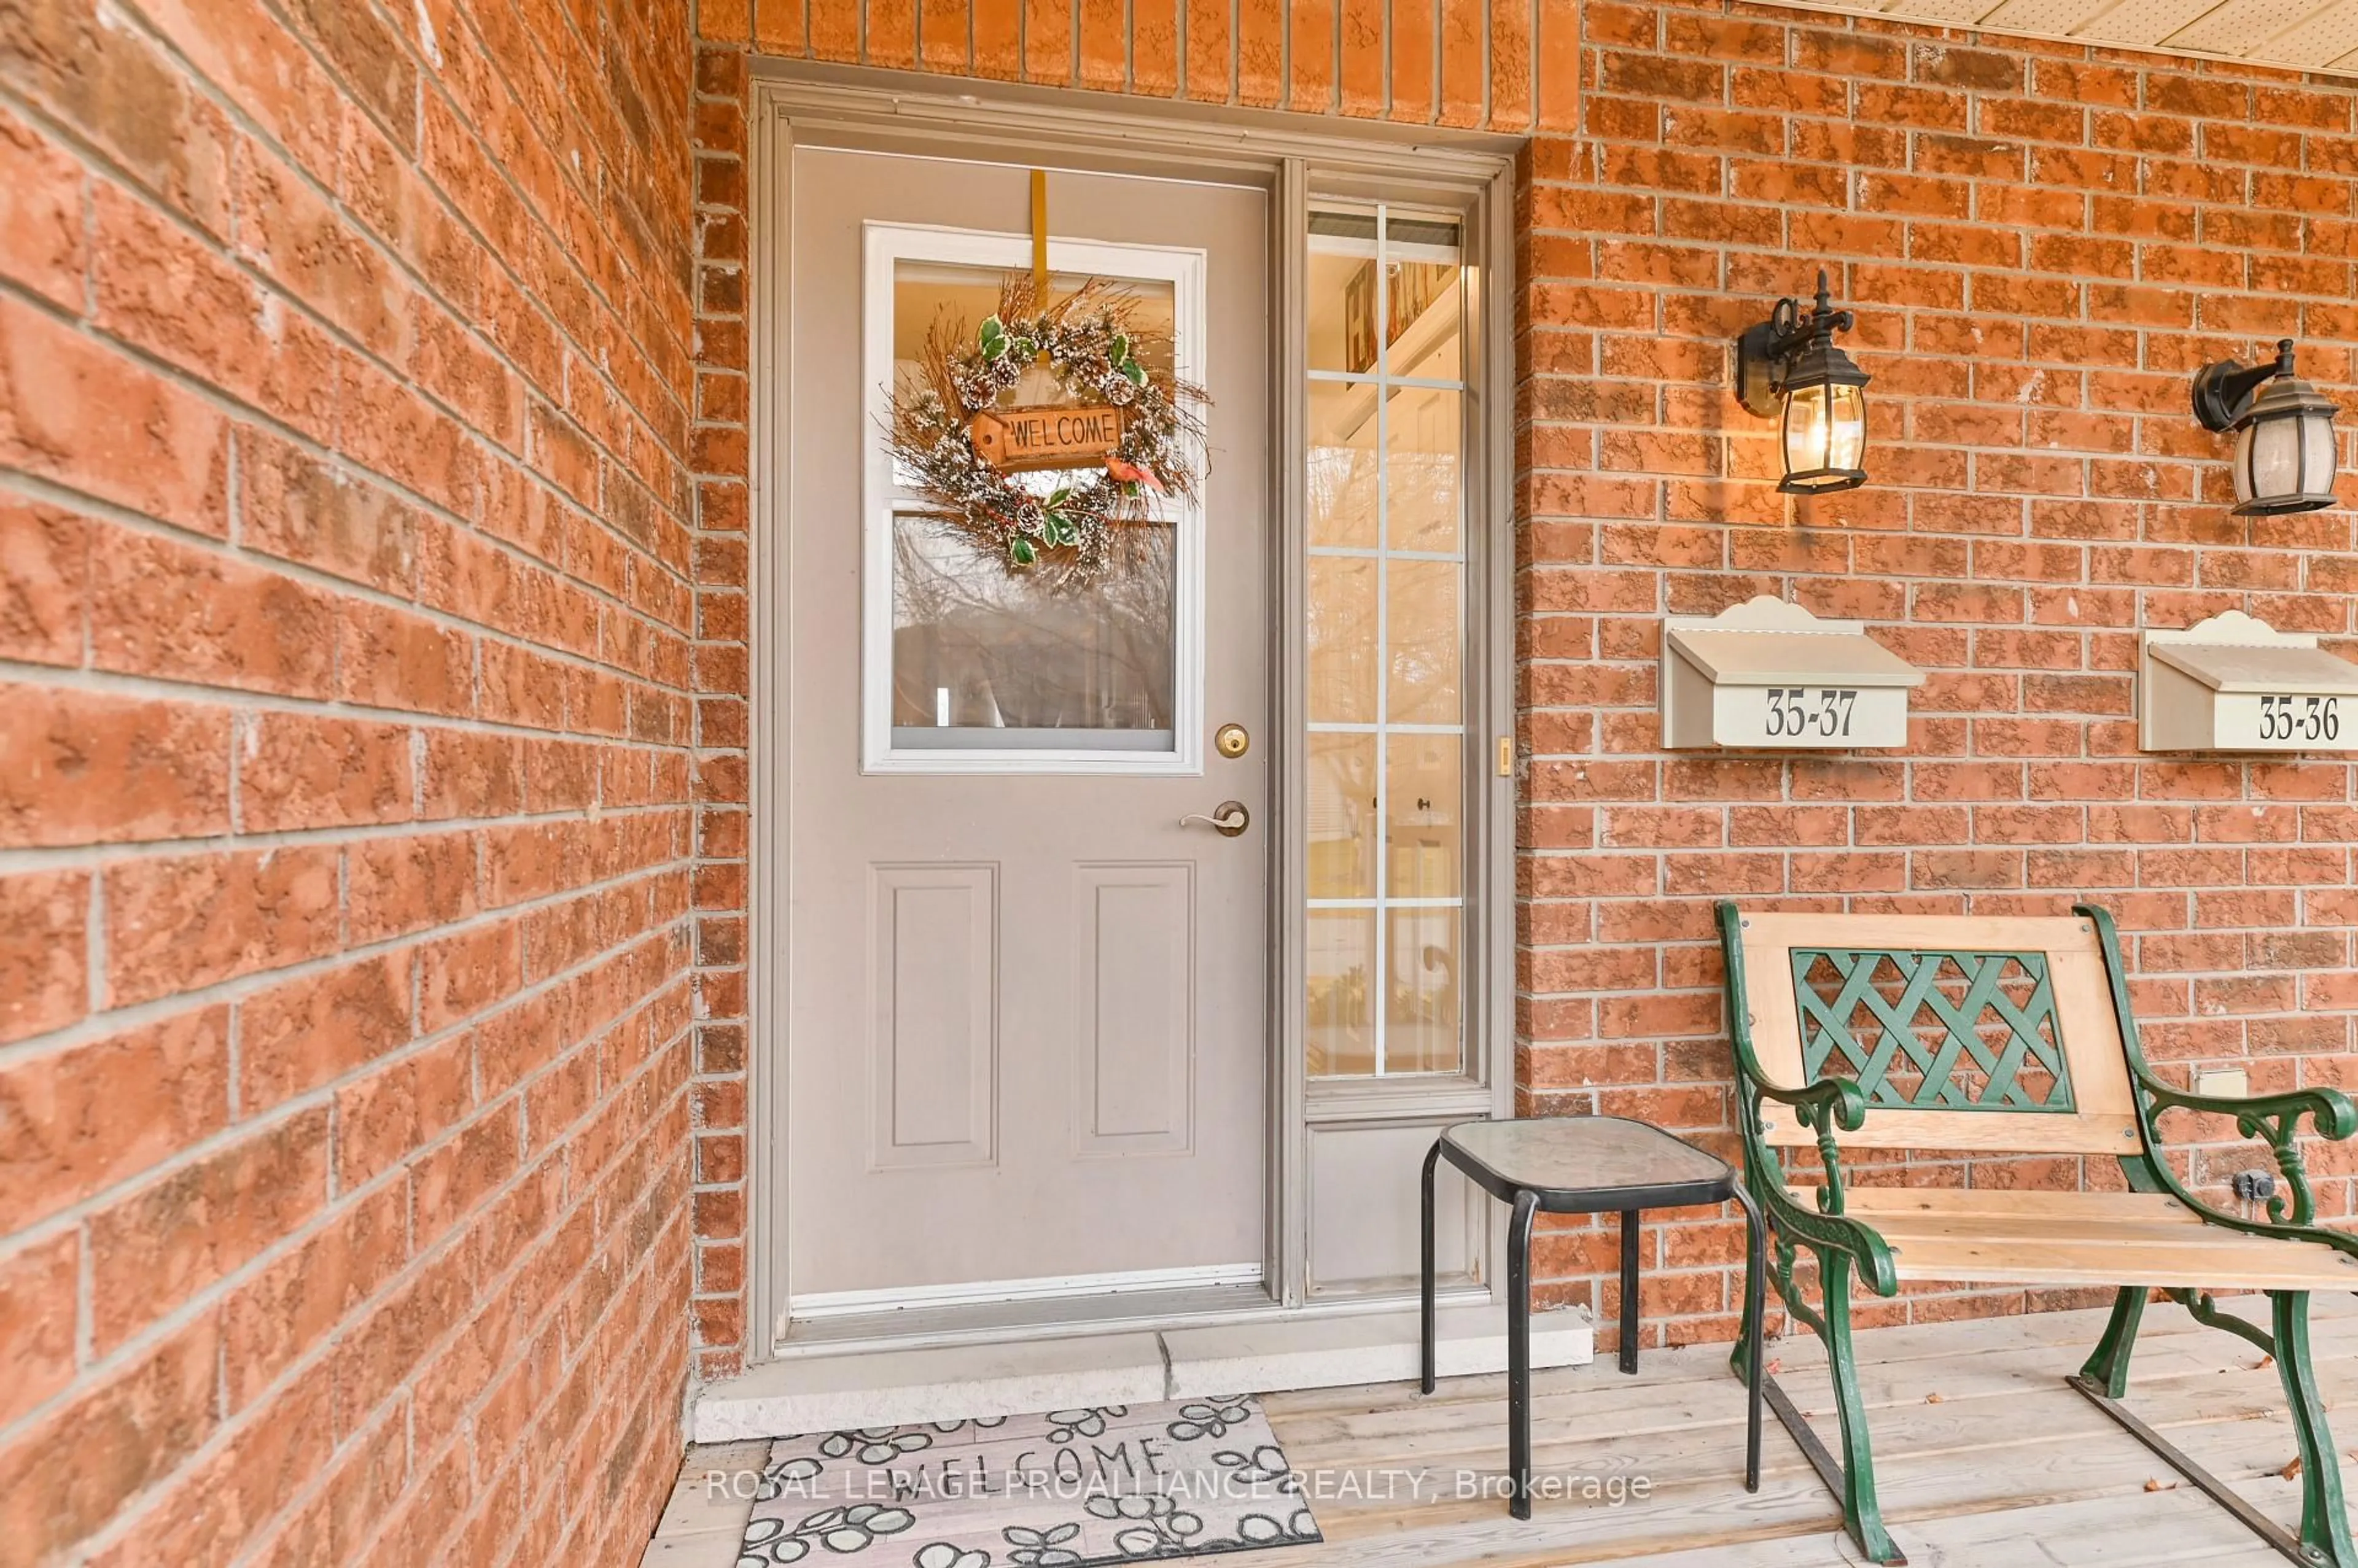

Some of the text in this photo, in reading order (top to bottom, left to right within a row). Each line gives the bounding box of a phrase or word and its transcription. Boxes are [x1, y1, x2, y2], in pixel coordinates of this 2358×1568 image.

[1011, 414, 1114, 448] WELCOME
[1765, 688, 1858, 737] 35-37
[2259, 694, 2339, 740] 35-36
[885, 1437, 1168, 1502] WELCOME
